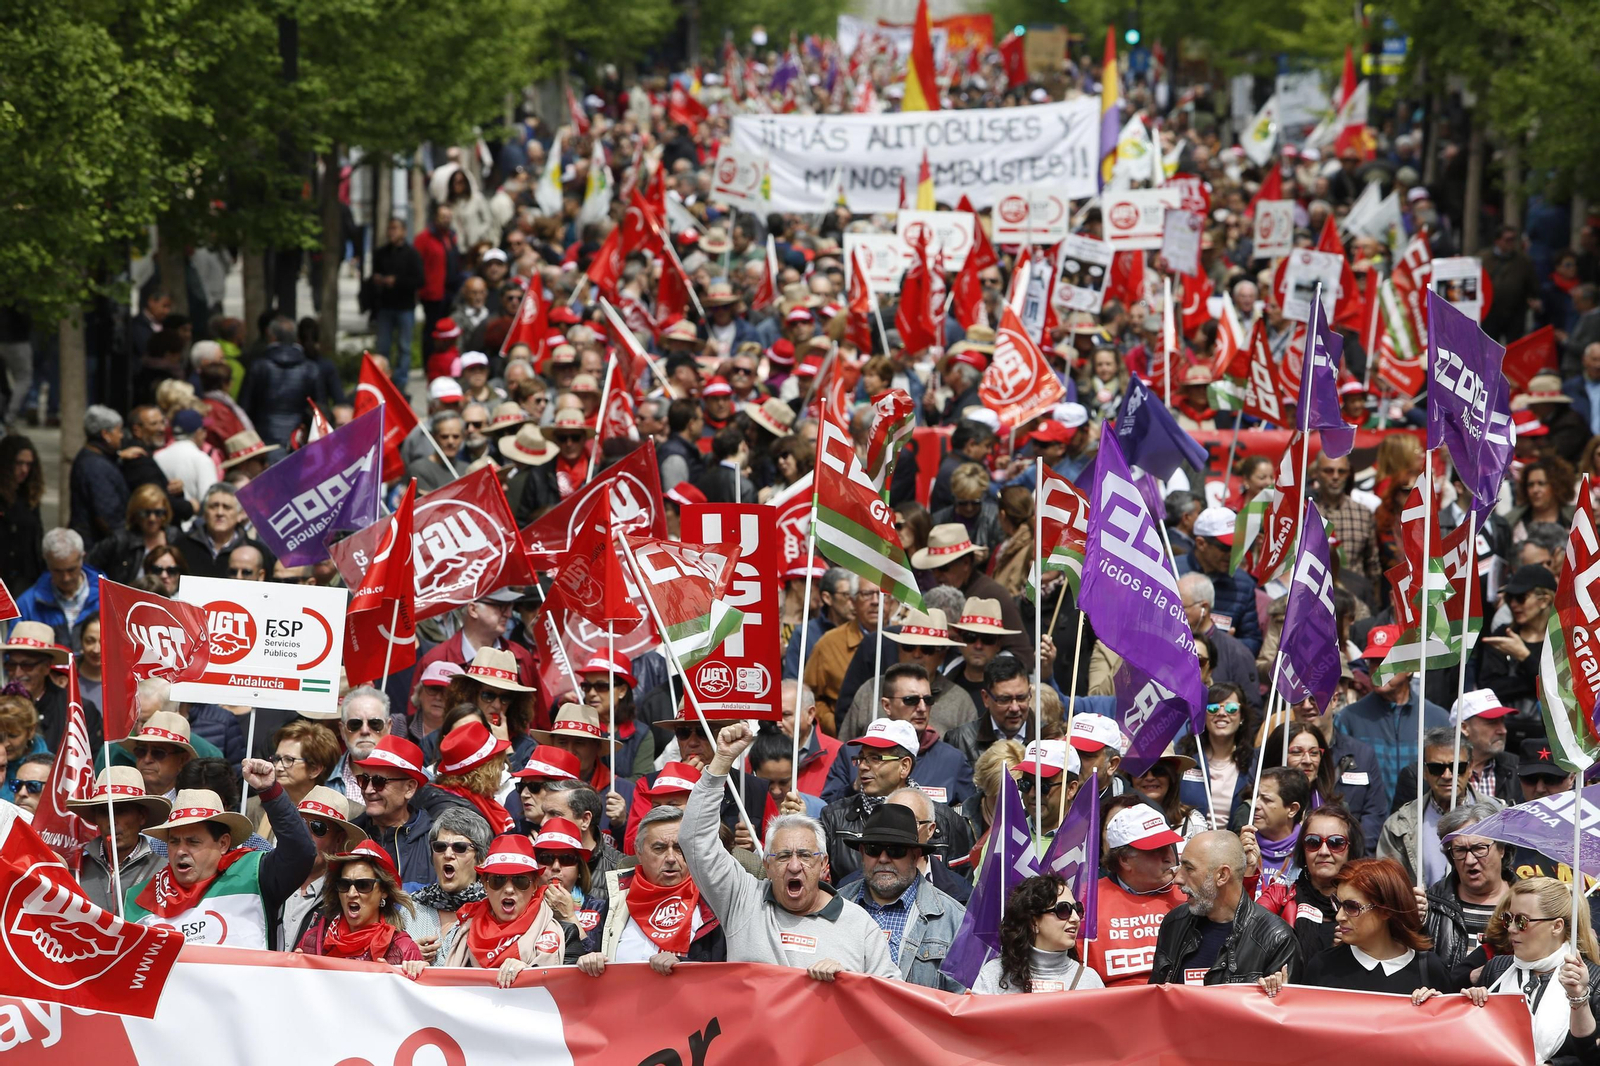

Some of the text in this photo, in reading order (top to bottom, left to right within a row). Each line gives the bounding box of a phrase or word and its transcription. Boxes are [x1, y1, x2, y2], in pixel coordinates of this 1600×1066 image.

[867, 116, 1042, 150] AUTOBUSES
[1058, 111, 1076, 138] Y
[1154, 589, 1168, 611] la
[265, 618, 304, 638] FeSP
[131, 622, 187, 670] UGT
[264, 639, 301, 649] Servicios
[263, 648, 298, 658] Públicos
[1573, 625, 1600, 698] Gran
[228, 674, 284, 689] Andalucía
[700, 667, 729, 683] UGT
[1074, 722, 1094, 733] CCOO
[1144, 818, 1164, 828] CCOO
[1109, 912, 1164, 929] SERVIC
[651, 930, 678, 940] GRA
[781, 933, 810, 945] CCOO
[1109, 929, 1130, 941] DE
[1111, 951, 1155, 971] CCO
[1187, 971, 1206, 980] CCO
[0, 1001, 98, 1052] ay
